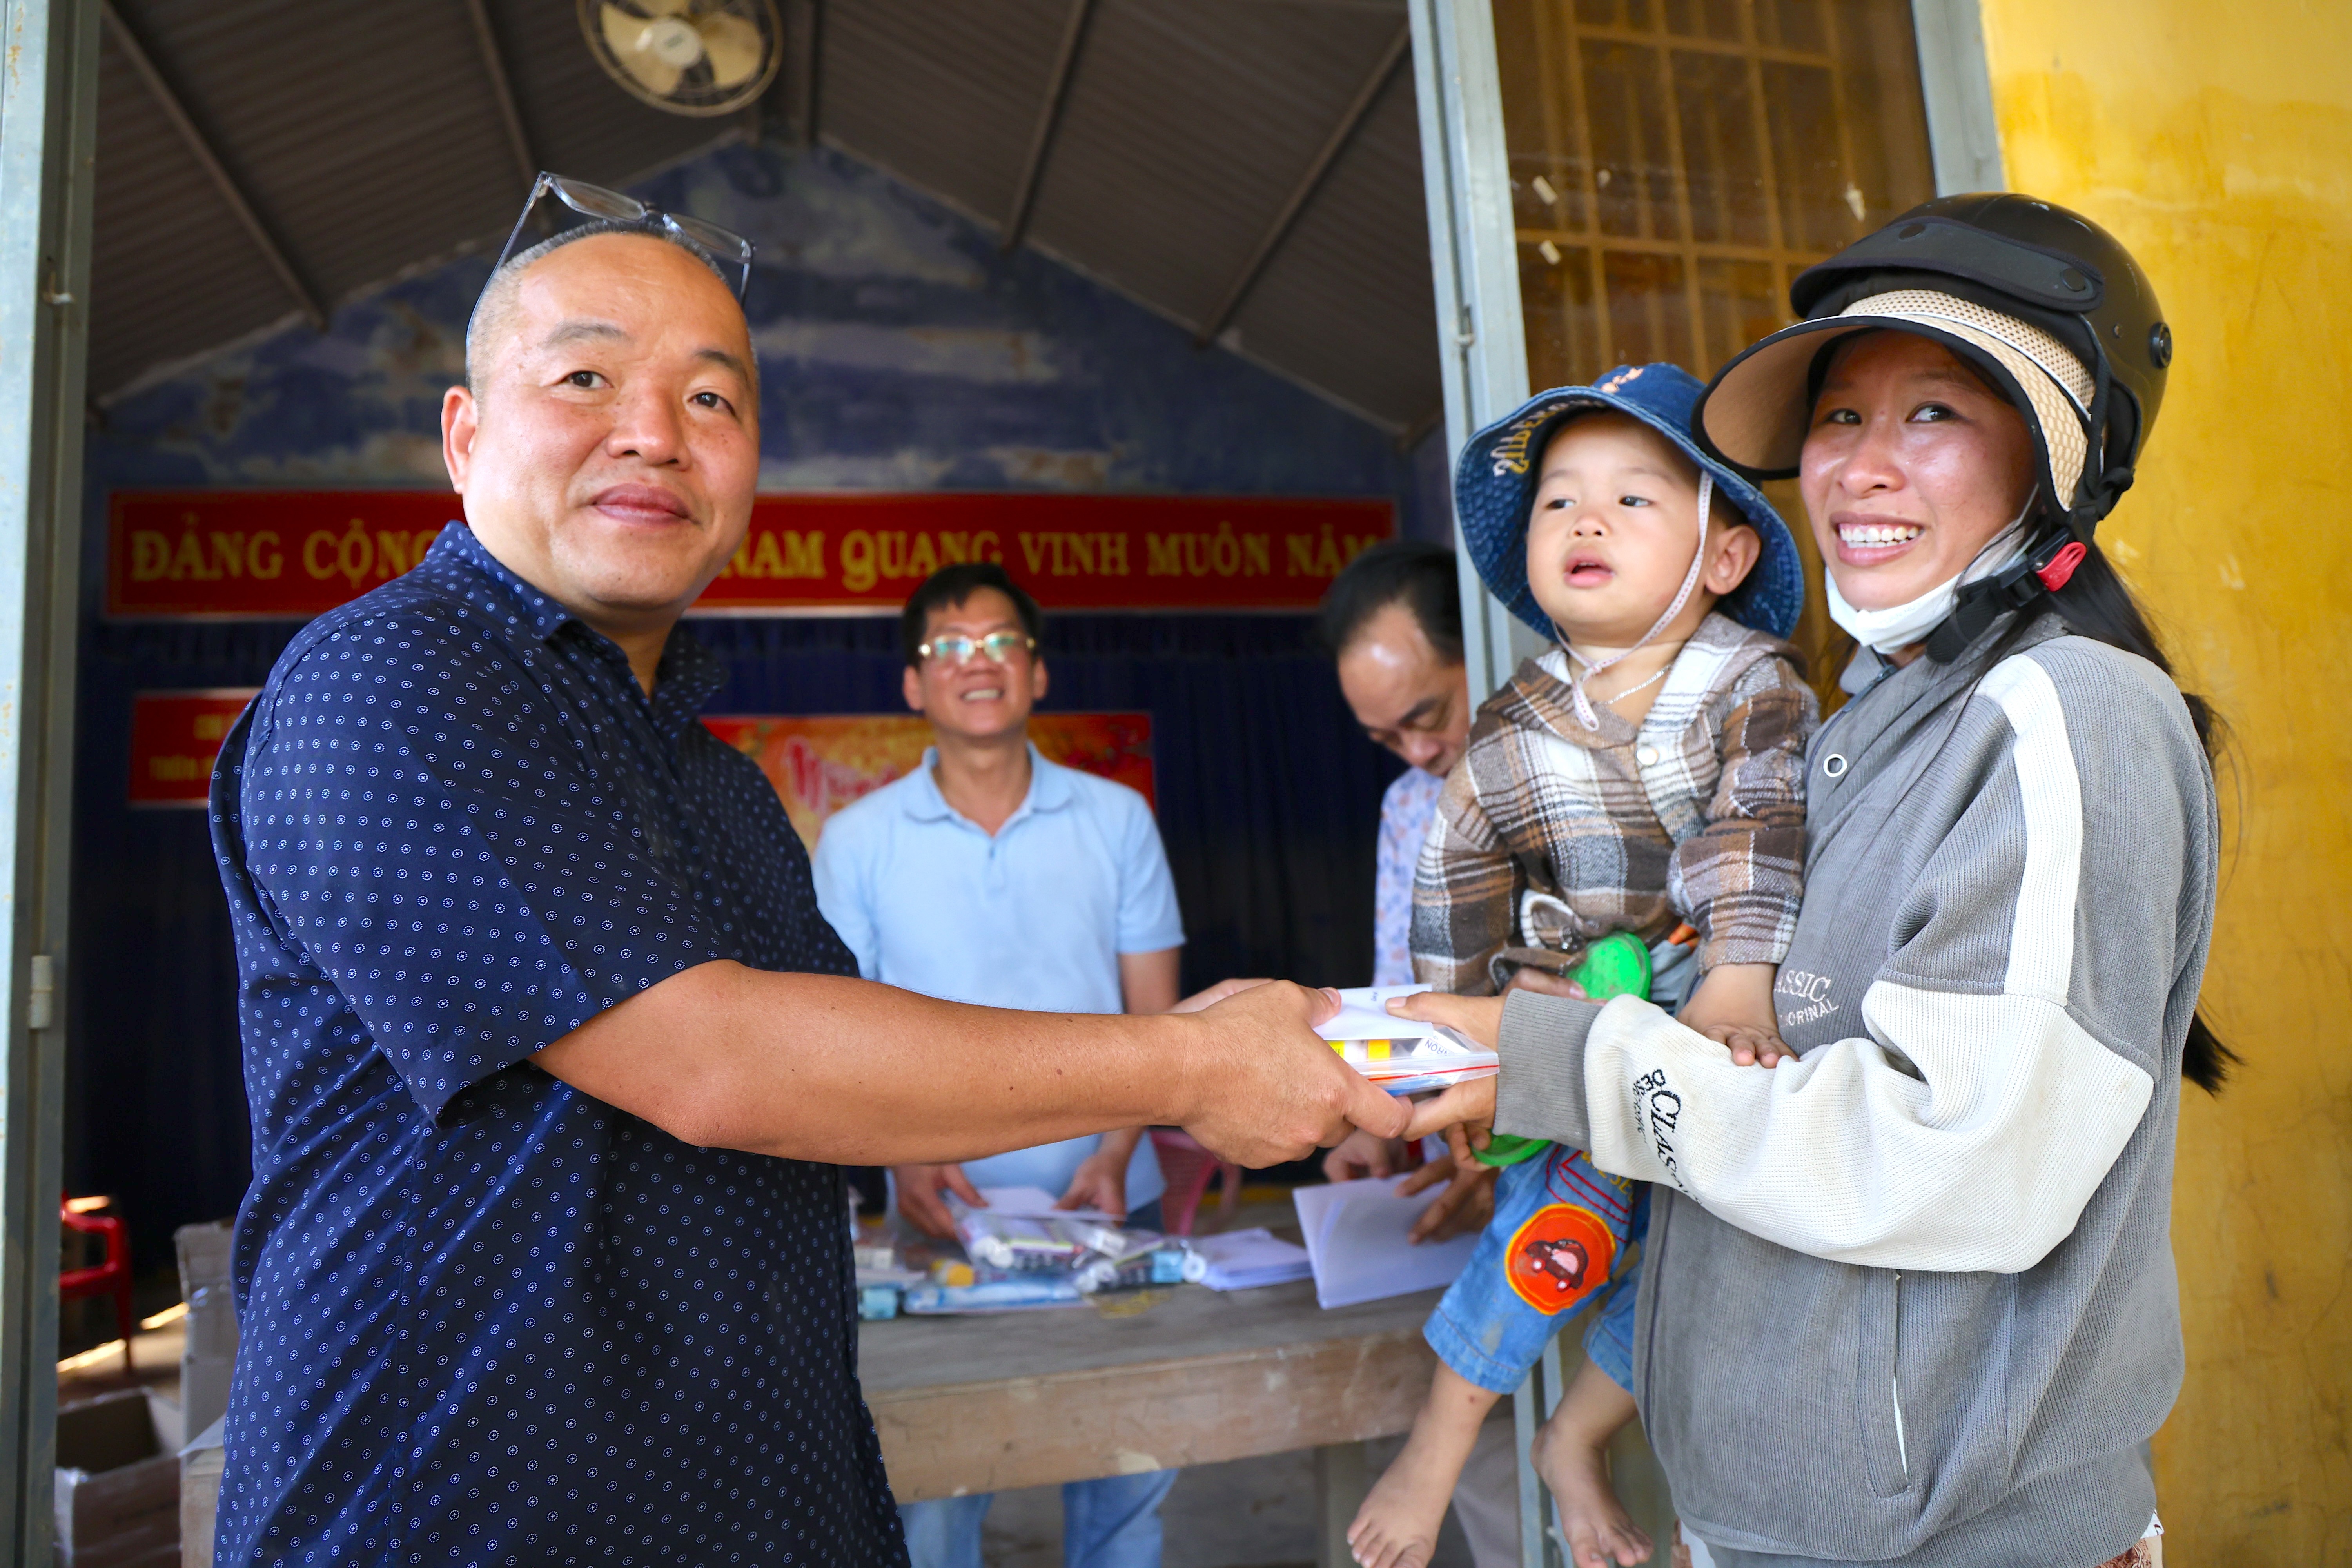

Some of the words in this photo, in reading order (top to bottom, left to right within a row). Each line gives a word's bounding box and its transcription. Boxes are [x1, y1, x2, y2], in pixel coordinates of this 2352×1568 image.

[130, 511, 283, 581] ĐẢNG
[1018, 531, 1130, 577] VINH
[1146, 521, 1270, 577] MUÔN
[1774, 970, 1832, 1002] ASSIC
